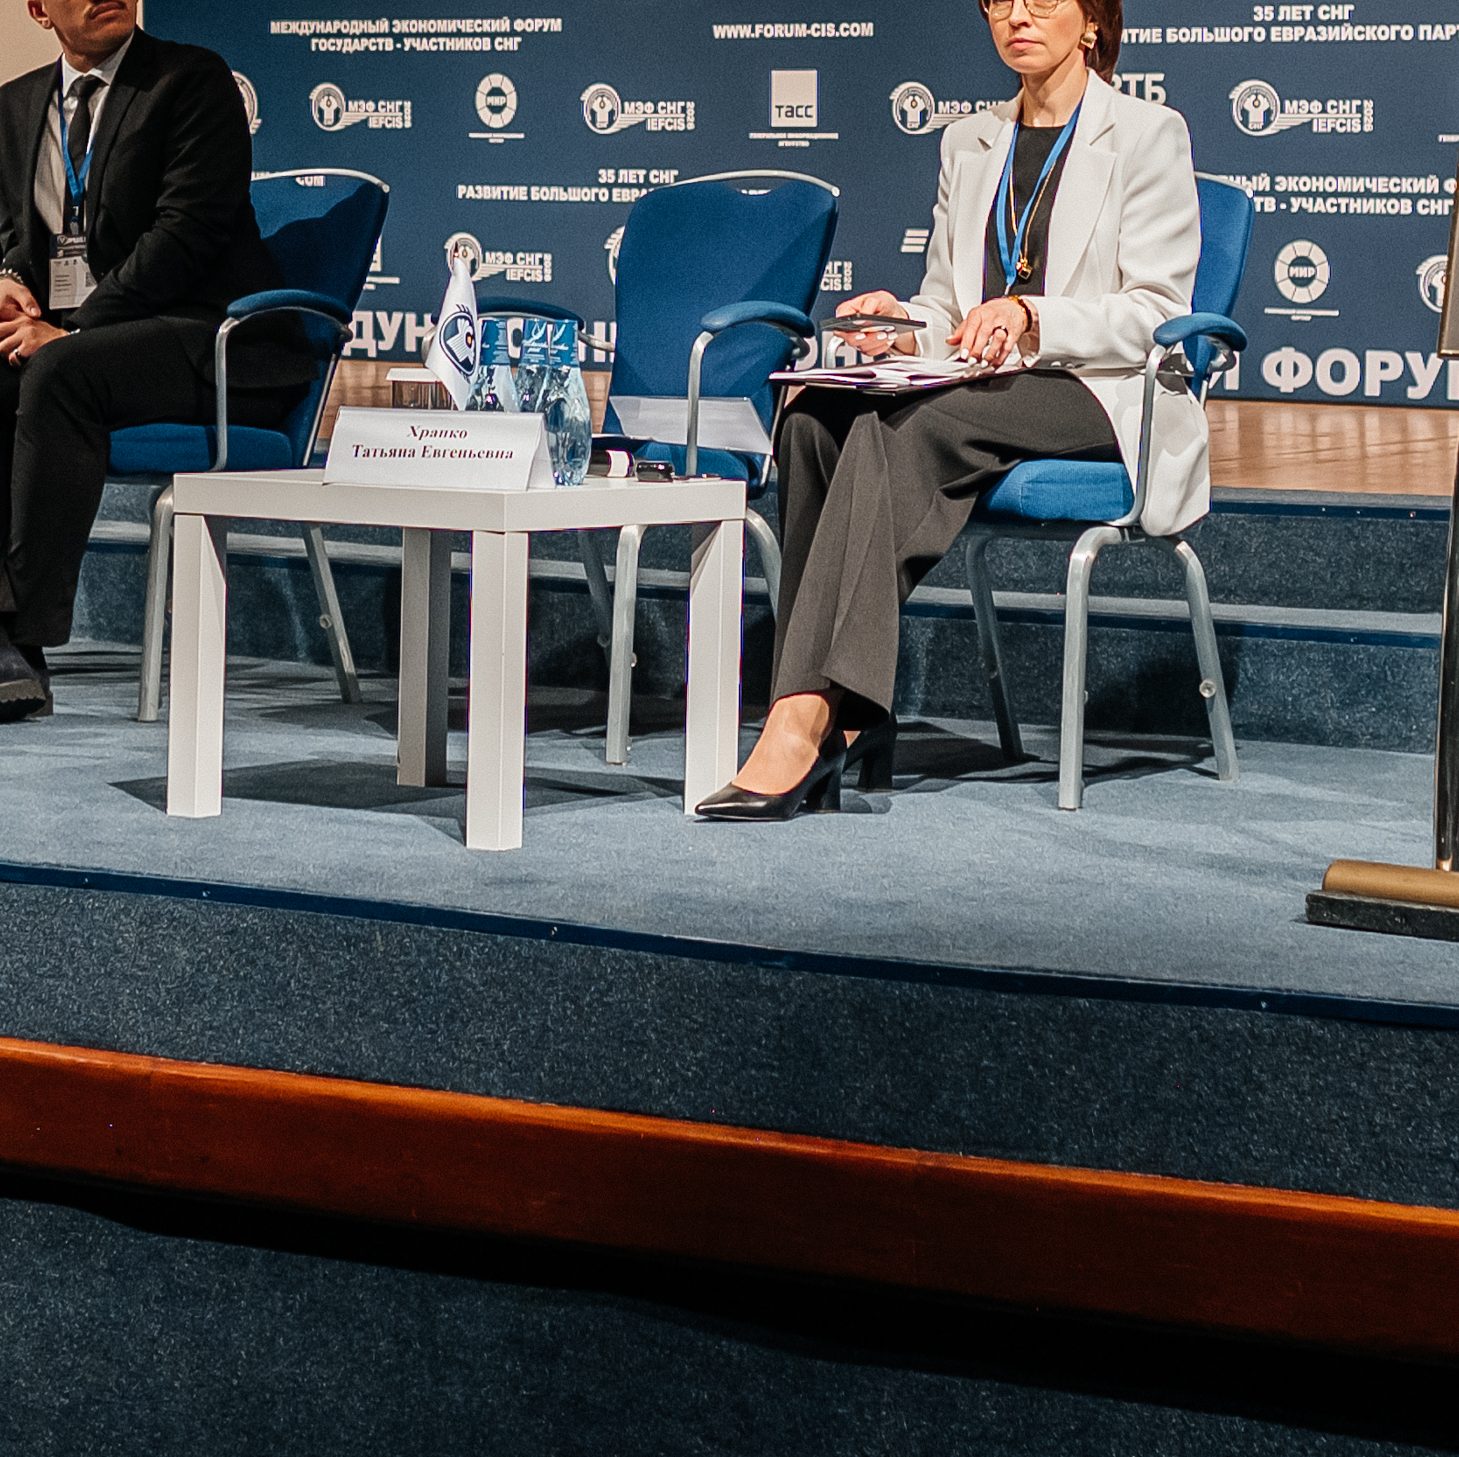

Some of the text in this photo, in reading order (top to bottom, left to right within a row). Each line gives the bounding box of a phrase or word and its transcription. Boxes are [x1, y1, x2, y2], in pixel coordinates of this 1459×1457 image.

[1253, 5, 1354, 21] 35 ЛЕТ СНГ
[270, 17, 562, 36] МЕЖДУНАРОДНЫЙ ЭКОНОМИЧЕСКИЙ ФОРУМ
[712, 22, 875, 38] WWW.FORUM-CIS.COM
[1166, 23, 1415, 43] БОЛЬШОГО ЕВРАЗИЙСКОГО
[311, 37, 522, 54] ГОСУДАРСТВ УЧАСТНИКОВ СНГ
[348, 100, 403, 113] МЭФ СНГ
[623, 101, 685, 115] МЭФ СНГ
[938, 100, 973, 114] МЭФ
[1283, 99, 1362, 115] МЭФ СНГ
[368, 115, 403, 128] IEFCIS
[646, 117, 685, 131] IEFCIS
[1312, 118, 1362, 133] IEFCIS
[598, 169, 679, 184] 35 ЛЕТ СНГ
[1274, 175, 1439, 194] ЭКОНОМИЧЕСКИЙ
[457, 185, 528, 201] РАЗВИТИЕ
[530, 186, 609, 202] БОЛЬШОГО
[1290, 198, 1412, 214] УЧАСТНИКОВ
[1416, 199, 1453, 215] СНГ
[485, 252, 543, 266] МЭФ СНГ
[505, 269, 543, 282] IEFCIS
[352, 444, 514, 460] Татьяна Евгеньевна
